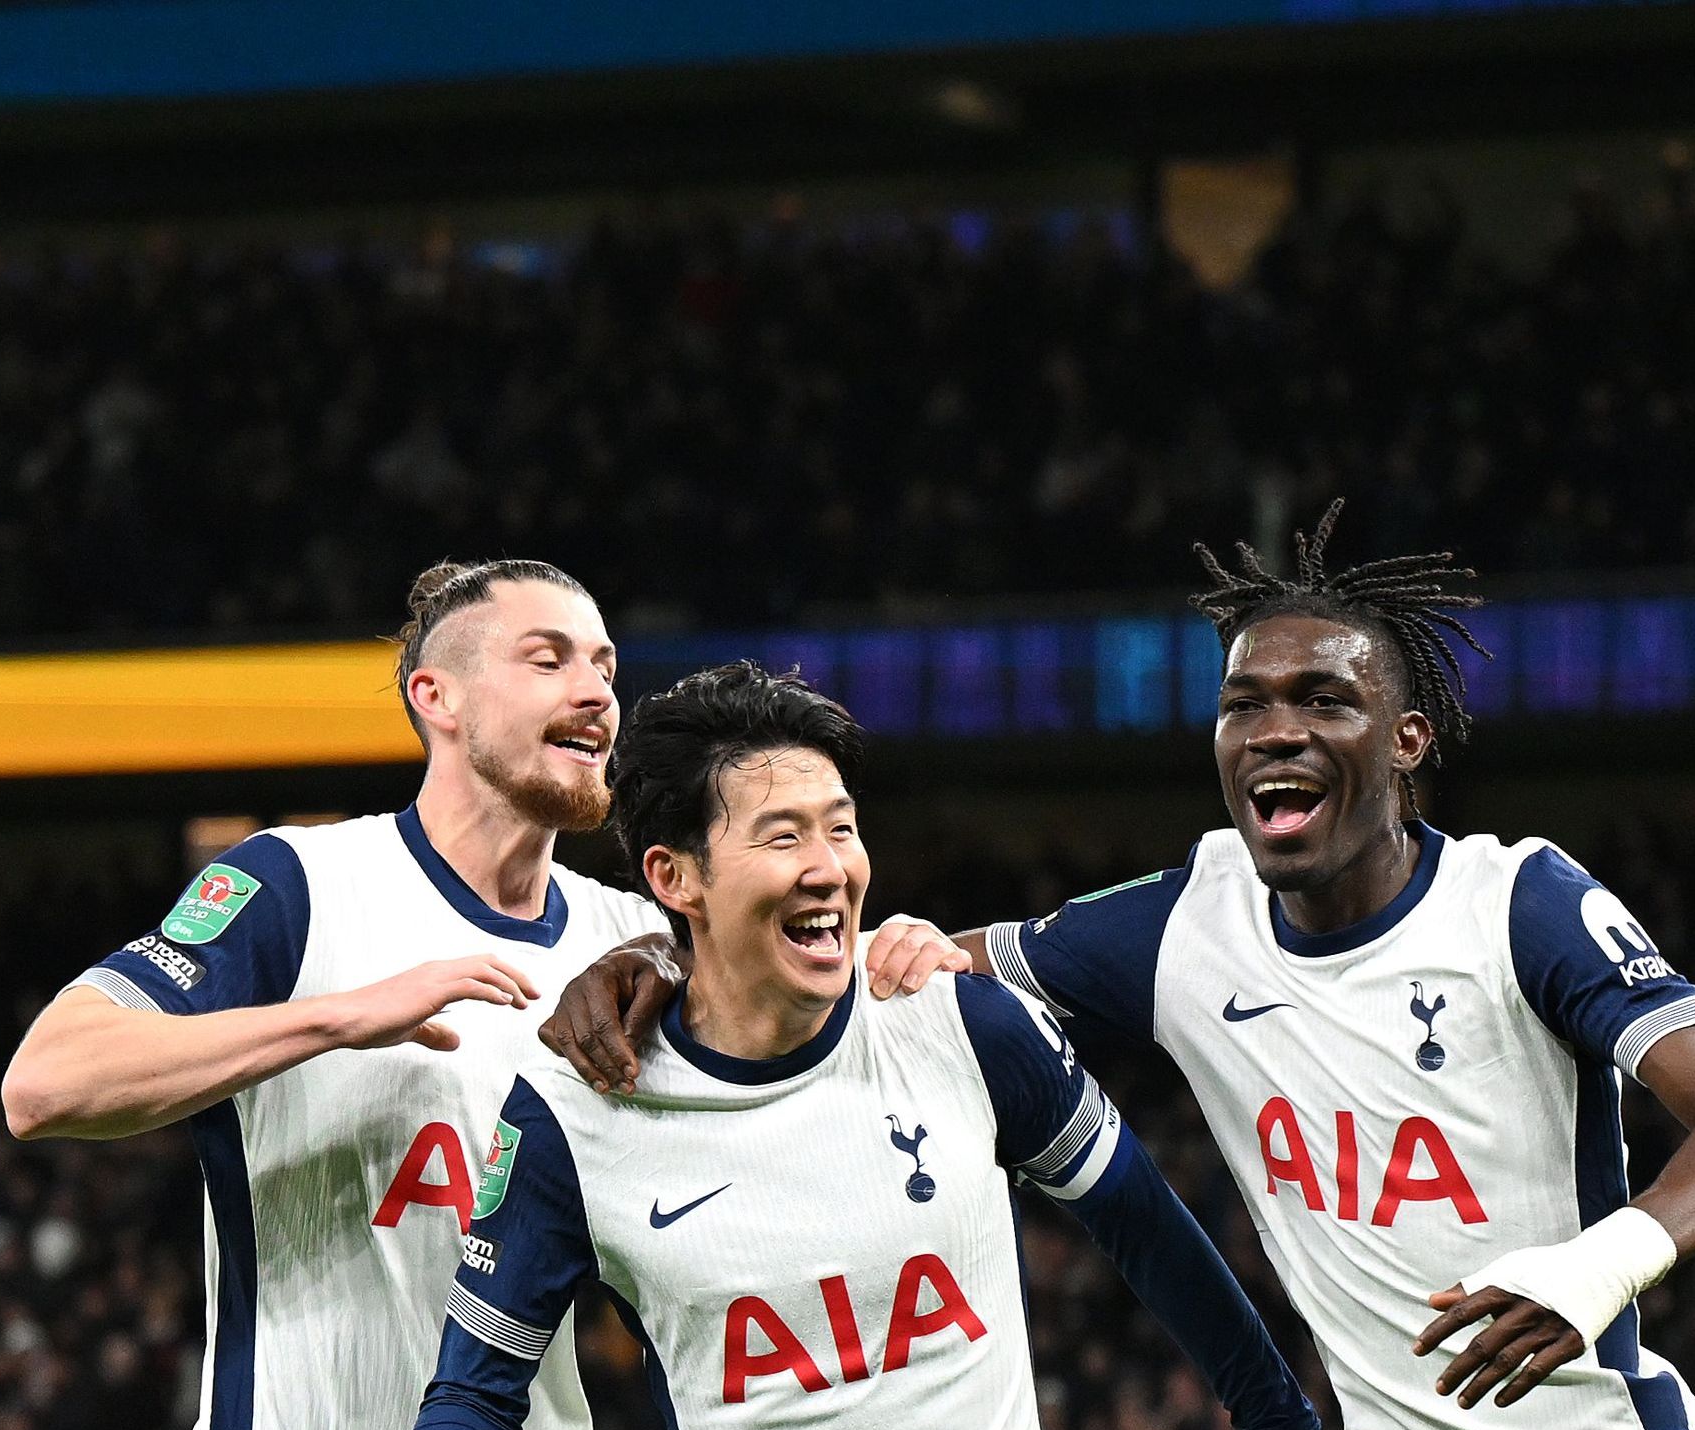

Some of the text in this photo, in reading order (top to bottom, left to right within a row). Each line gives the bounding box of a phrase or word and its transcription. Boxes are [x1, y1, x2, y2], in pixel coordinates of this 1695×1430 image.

[181, 905, 209, 921] Cup
[152, 941, 197, 977] room
[1256, 1096, 1489, 1227] AIA
[722, 1253, 989, 1404] AIA
